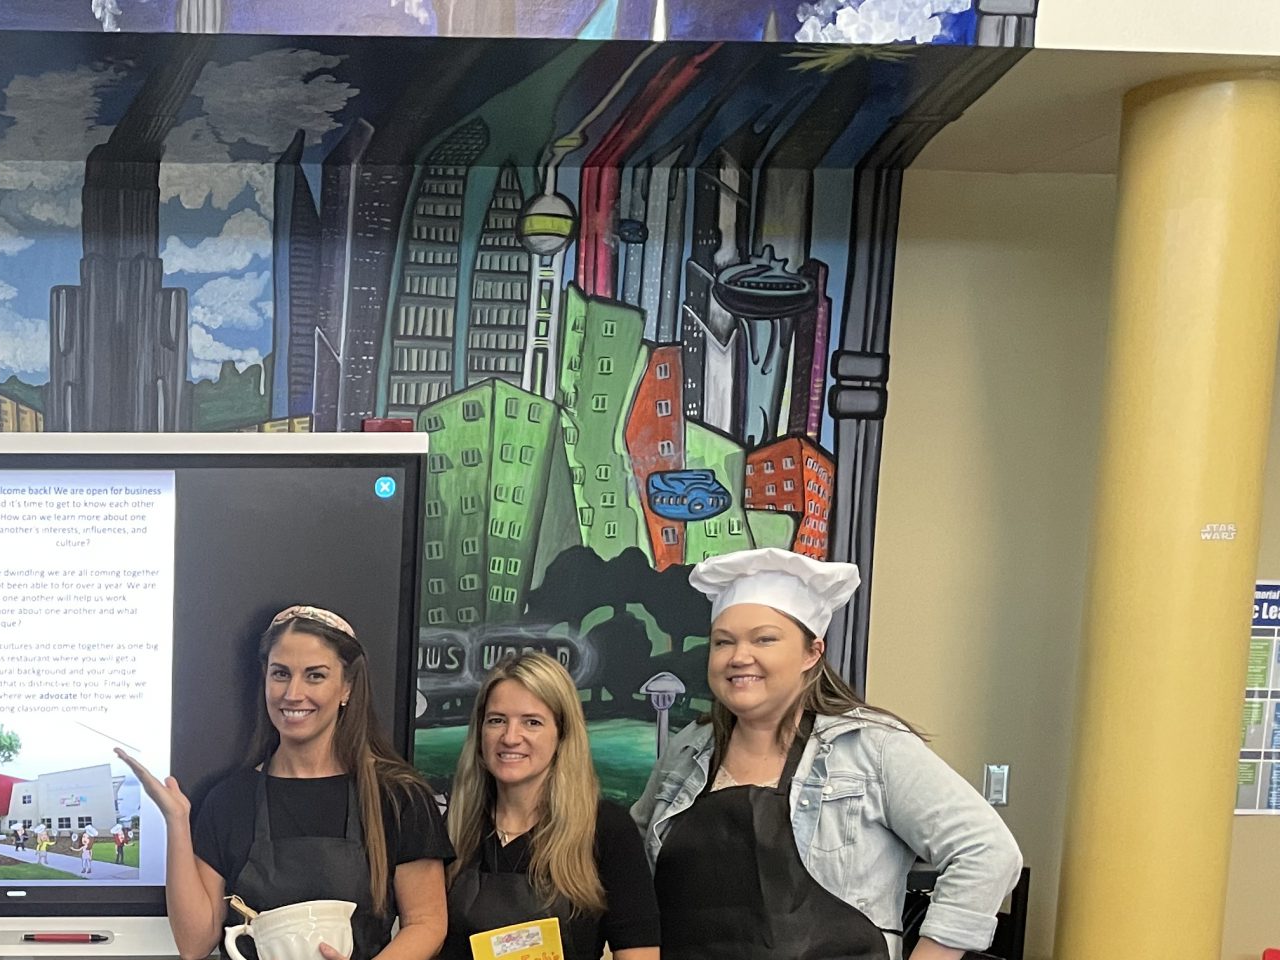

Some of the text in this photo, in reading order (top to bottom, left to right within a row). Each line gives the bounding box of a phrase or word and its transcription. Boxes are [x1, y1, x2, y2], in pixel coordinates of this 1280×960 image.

[28, 486, 52, 495] back!
[53, 486, 69, 495] We
[85, 488, 109, 496] open
[110, 486, 123, 495] for
[124, 486, 162, 495] business
[9, 499, 21, 508] it's
[23, 499, 43, 508] time
[45, 499, 55, 508] to
[56, 499, 70, 510] get
[72, 499, 82, 508] to
[83, 499, 107, 508] know
[108, 499, 129, 508] each
[0, 512, 20, 521] How
[53, 512, 76, 521] learn
[102, 512, 128, 521] about
[42, 525, 81, 536] interests,
[82, 525, 129, 536] influences,
[130, 525, 148, 534] and
[1200, 524, 1237, 532] STAR
[1200, 532, 1237, 540] WARS
[55, 538, 91, 547] culture?
[3, 568, 46, 578] dwindling
[78, 568, 88, 577] all
[90, 568, 121, 578] coming
[6, 581, 28, 590] been
[30, 581, 49, 590] able
[50, 581, 60, 590] to
[61, 581, 74, 590] for
[126, 581, 141, 590] We
[20, 593, 55, 602] another
[56, 593, 72, 602] will
[73, 593, 92, 604] help
[17, 606, 43, 615] about
[62, 606, 97, 615] another
[98, 606, 115, 615] and
[116, 606, 138, 615] what
[1262, 602, 1280, 620] Le
[34, 641, 51, 650] and
[145, 641, 159, 652] big
[7, 654, 50, 663] restaurant
[52, 654, 79, 663] where
[81, 656, 97, 664] you
[98, 654, 114, 663] will
[115, 654, 129, 664] get
[16, 666, 67, 676] background
[68, 666, 84, 675] and
[86, 668, 105, 676] your
[107, 666, 137, 676] unique
[0, 679, 17, 688] that
[18, 679, 27, 688] is
[72, 679, 82, 688] to
[38, 691, 78, 700] advocate
[79, 691, 92, 700] for
[94, 691, 112, 700] how
[128, 691, 144, 700] will
[16, 703, 60, 712] classroom
